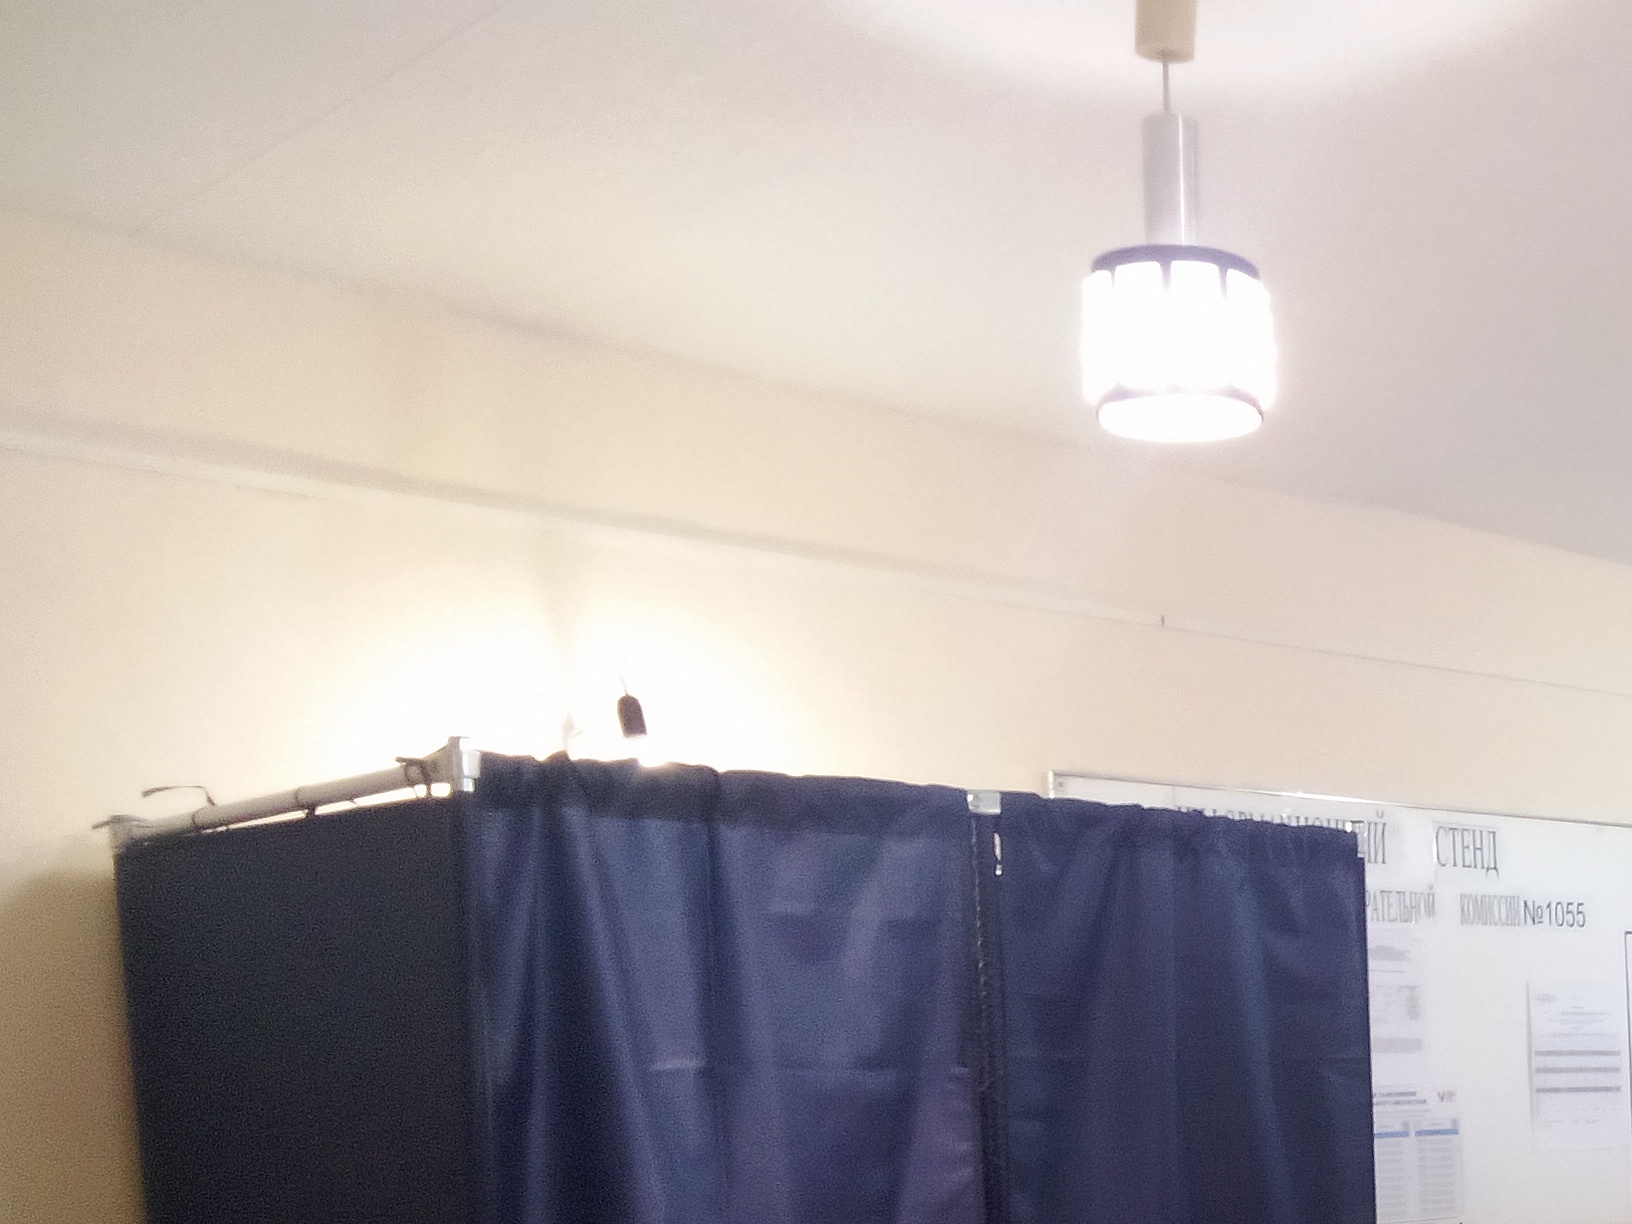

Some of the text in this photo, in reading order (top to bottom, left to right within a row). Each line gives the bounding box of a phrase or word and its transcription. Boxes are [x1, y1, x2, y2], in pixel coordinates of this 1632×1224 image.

[1435, 826, 1500, 878] СТЕНД
[1366, 884, 1436, 925] РАТЕЛЬНОЙ
[1523, 900, 1587, 928] №1055
